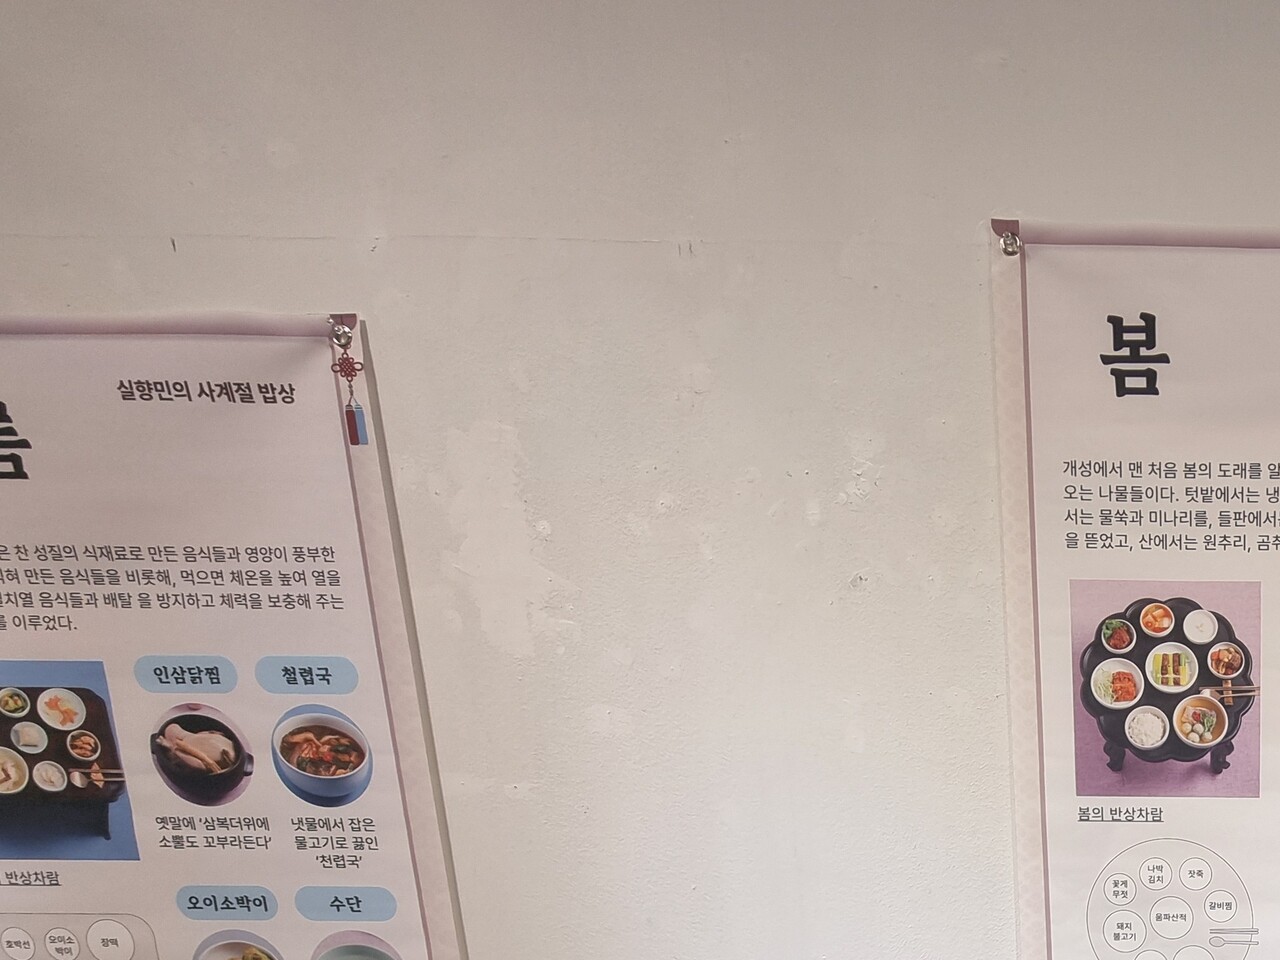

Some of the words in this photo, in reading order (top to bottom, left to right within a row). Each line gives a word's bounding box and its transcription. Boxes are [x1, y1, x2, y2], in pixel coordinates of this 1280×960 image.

[1099, 310, 1171, 398] 봄
[116, 379, 191, 402] 실향민의
[197, 381, 256, 404] 사계절
[259, 383, 296, 405] 밥상
[1063, 461, 1123, 478] 개성에서
[1129, 462, 1142, 478] 맨
[1148, 462, 1178, 479] 처음
[1183, 462, 1212, 479] 봄의
[1218, 463, 1262, 479] 도래를
[1064, 485, 1093, 501] 오는
[1099, 485, 1179, 502] 나물들이다.
[1186, 486, 1260, 503] 텃밭에서는
[1065, 509, 1093, 525] 서는
[1099, 510, 1143, 526] 물쑥과
[1149, 510, 1212, 528] 미나리를,
[1065, 532, 1079, 548] 을
[1085, 533, 1133, 551] 뜯었고,
[1139, 534, 1197, 550] 산에서는
[1203, 534, 1251, 552] 원추리,
[14, 545, 29, 561] 찬
[34, 545, 78, 561] 성질의
[83, 545, 145, 561] 식재료로
[148, 546, 178, 562] 만든
[183, 546, 240, 562] 음식들과
[245, 547, 287, 562] 영양이
[292, 547, 335, 563] 풍부한
[25, 569, 54, 584] 만든
[60, 569, 121, 585] 음식들을
[126, 570, 175, 587] 비롯해,
[181, 570, 224, 586] 먹으면
[230, 570, 272, 586] 체온을
[278, 570, 307, 586] 높여
[312, 570, 341, 586] 열을
[39, 592, 98, 608] 음식들과
[103, 593, 132, 609] 배탈
[138, 593, 152, 609] 을
[157, 593, 215, 609] 방지하고
[220, 593, 262, 609] 체력을
[268, 594, 311, 609] 보충해
[316, 594, 344, 609] 주는
[13, 615, 77, 630] 이루었다.
[154, 666, 221, 685] 인삼닭찜
[1078, 807, 1104, 821] 봄의
[1110, 807, 1164, 822] 반상차람
[155, 817, 196, 831] 옛말에
[291, 818, 344, 832] 냇물에서
[349, 818, 375, 832] 잡은
[295, 837, 348, 850] 물고기로
[352, 837, 378, 850] 끓인
[5, 872, 60, 886] 반상차람
[188, 895, 268, 912] 오이소박이
[330, 896, 362, 913] 수단
